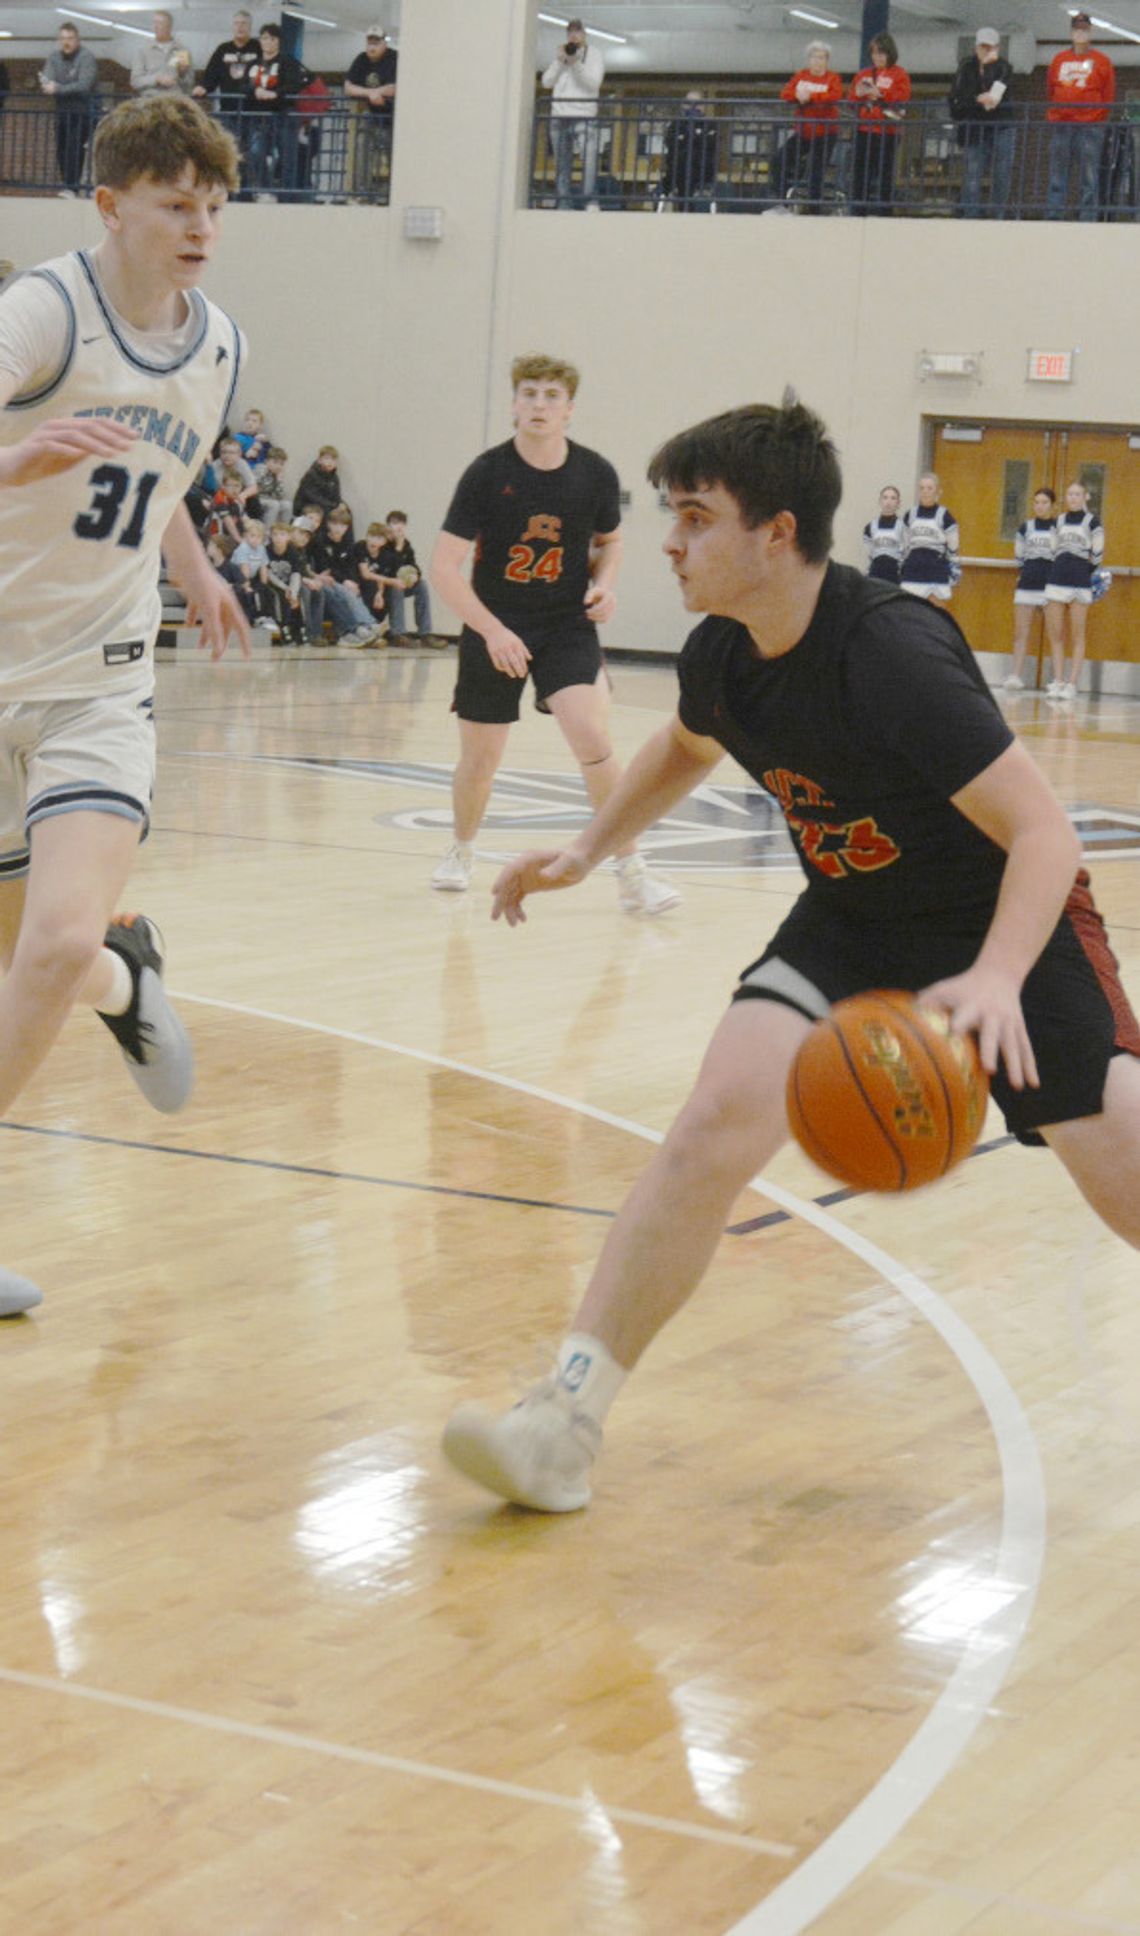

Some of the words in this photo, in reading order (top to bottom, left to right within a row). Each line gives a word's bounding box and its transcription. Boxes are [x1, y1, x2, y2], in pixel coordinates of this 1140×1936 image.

[1036, 354, 1064, 377] EXIT
[74, 463, 160, 549] 31
[505, 545, 564, 583] 24
